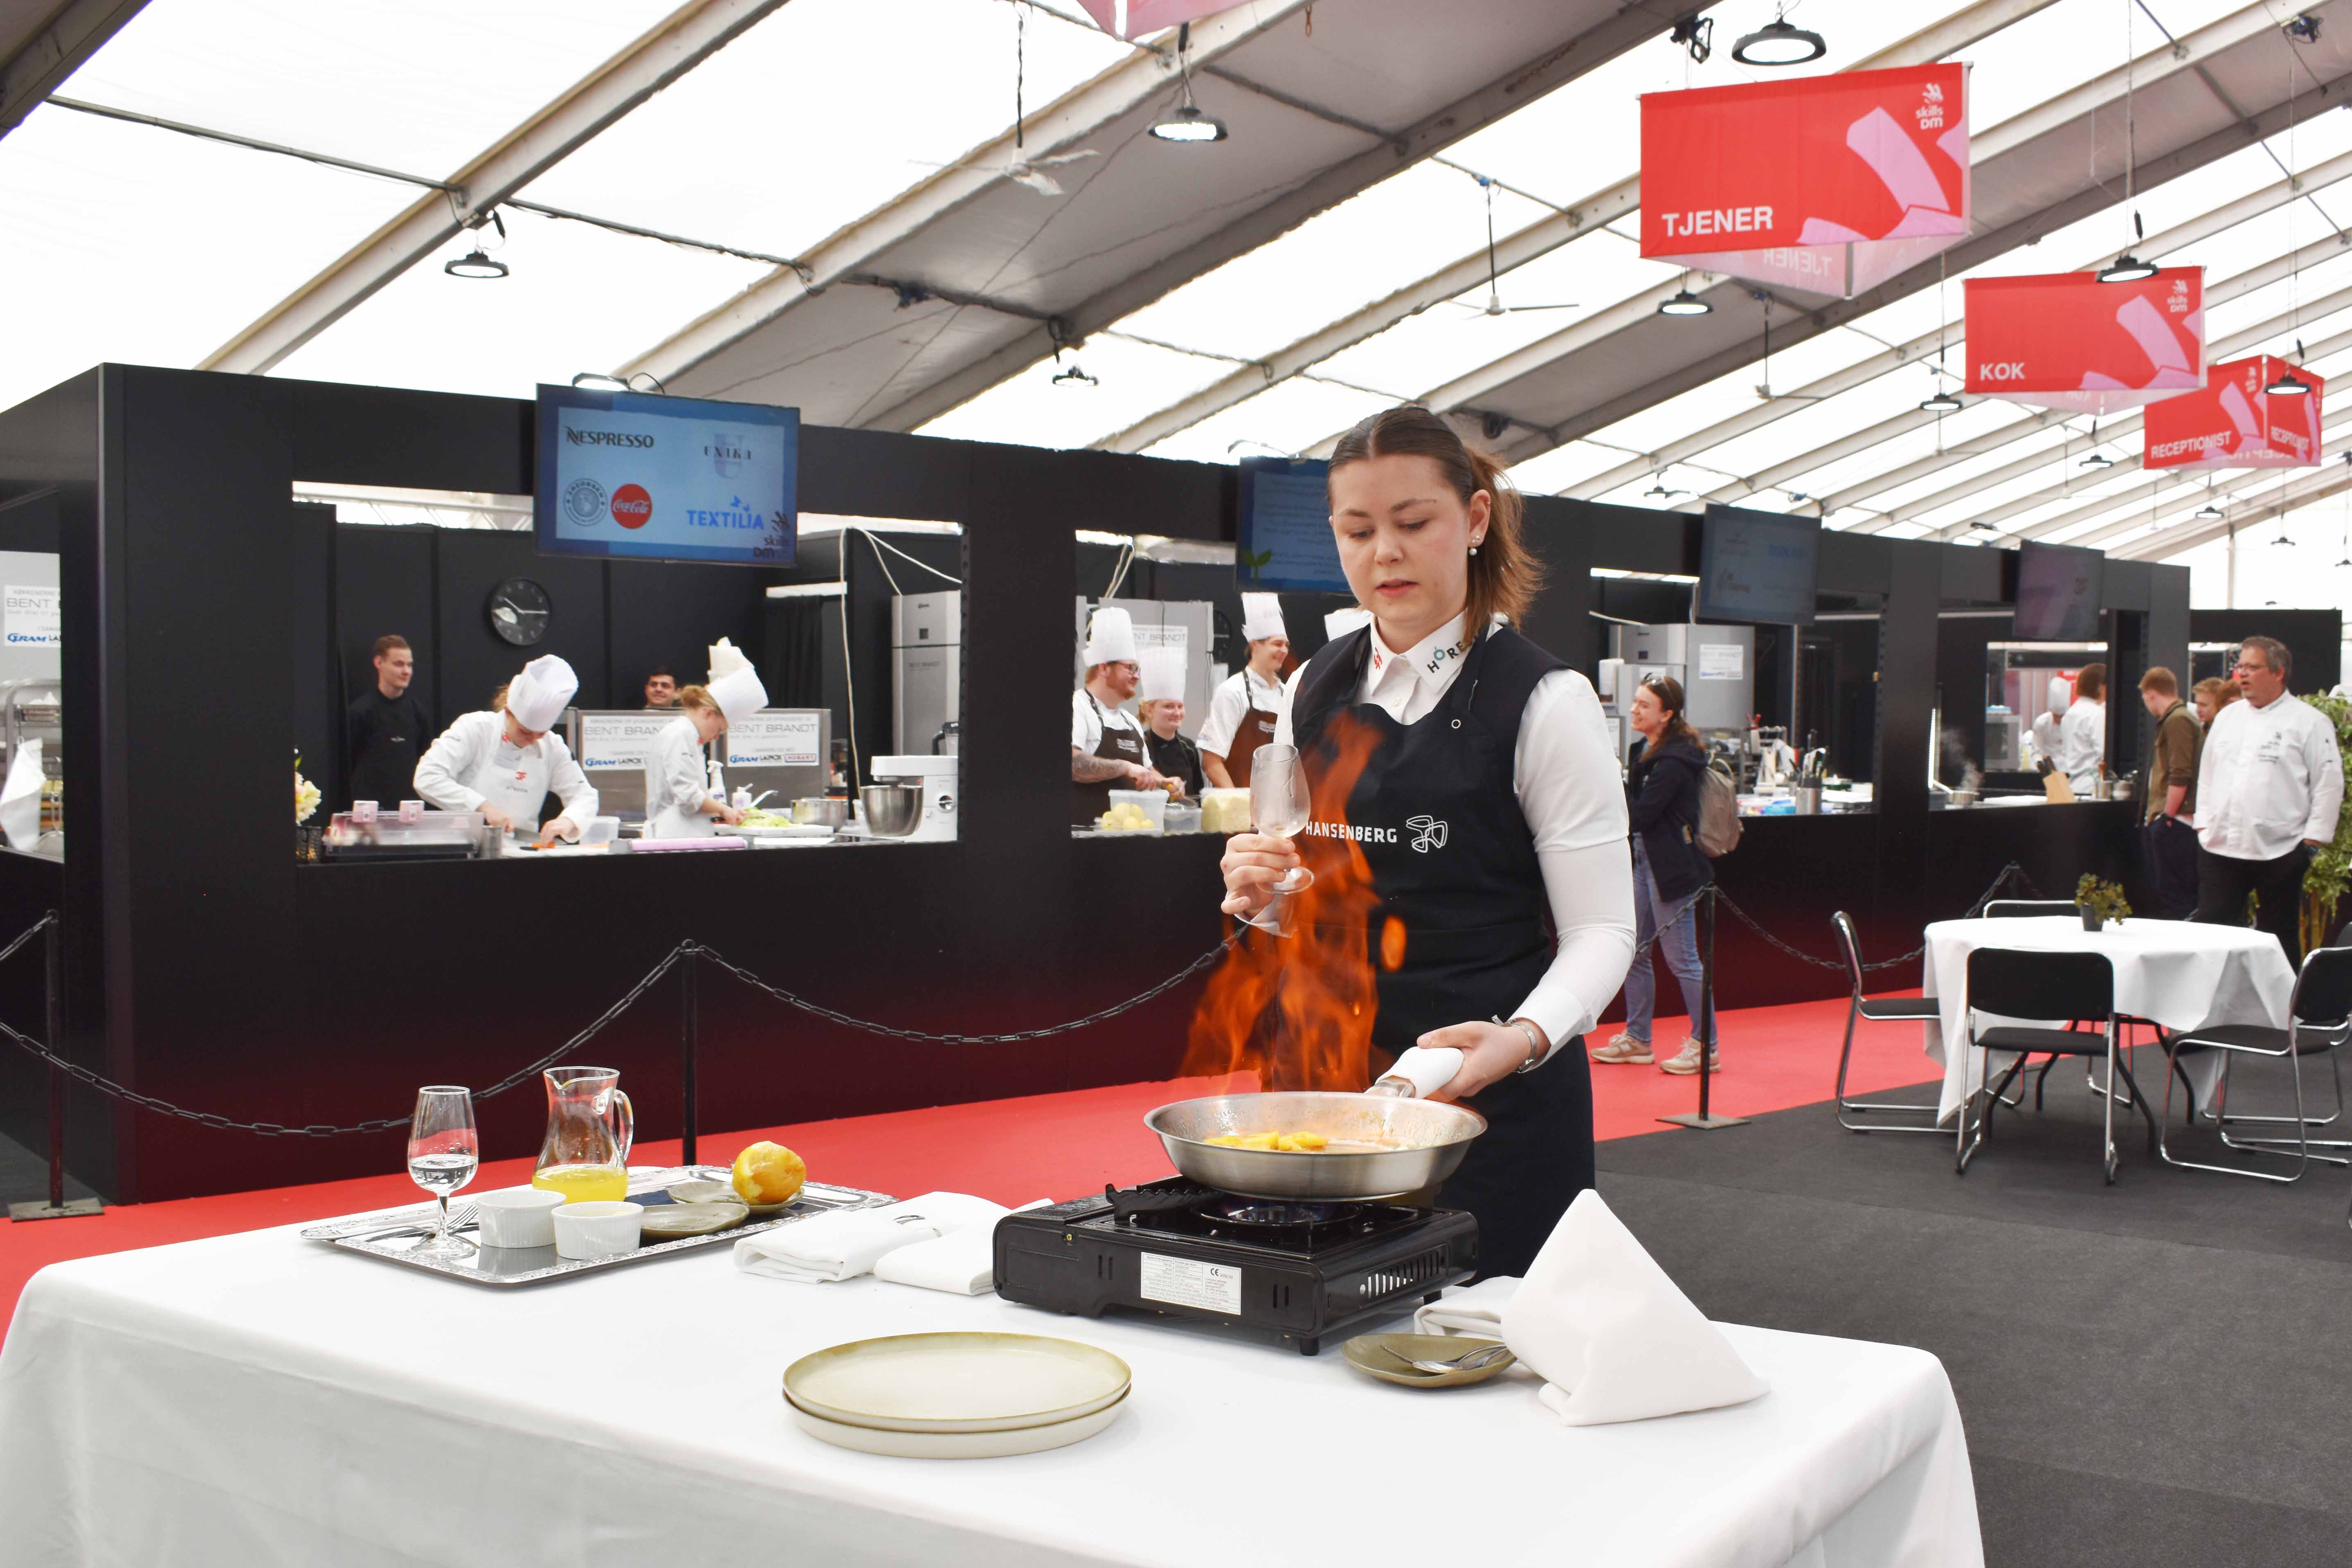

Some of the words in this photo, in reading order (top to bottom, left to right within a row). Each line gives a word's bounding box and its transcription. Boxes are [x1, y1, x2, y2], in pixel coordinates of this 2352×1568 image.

[1915, 105, 1944, 119] skills
[1661, 206, 1773, 238] TJENER
[1980, 362, 2025, 381] KOK
[566, 426, 654, 448] NESPRESSO
[2150, 431, 2232, 459] RECEPTIONIST
[686, 510, 764, 530] TEXTILIA
[7, 598, 51, 608] BENT
[585, 726, 620, 735] BENT
[625, 726, 661, 735] BRAN
[766, 724, 817, 733] BRANDT
[1305, 821, 1398, 843] HANSENBERG
